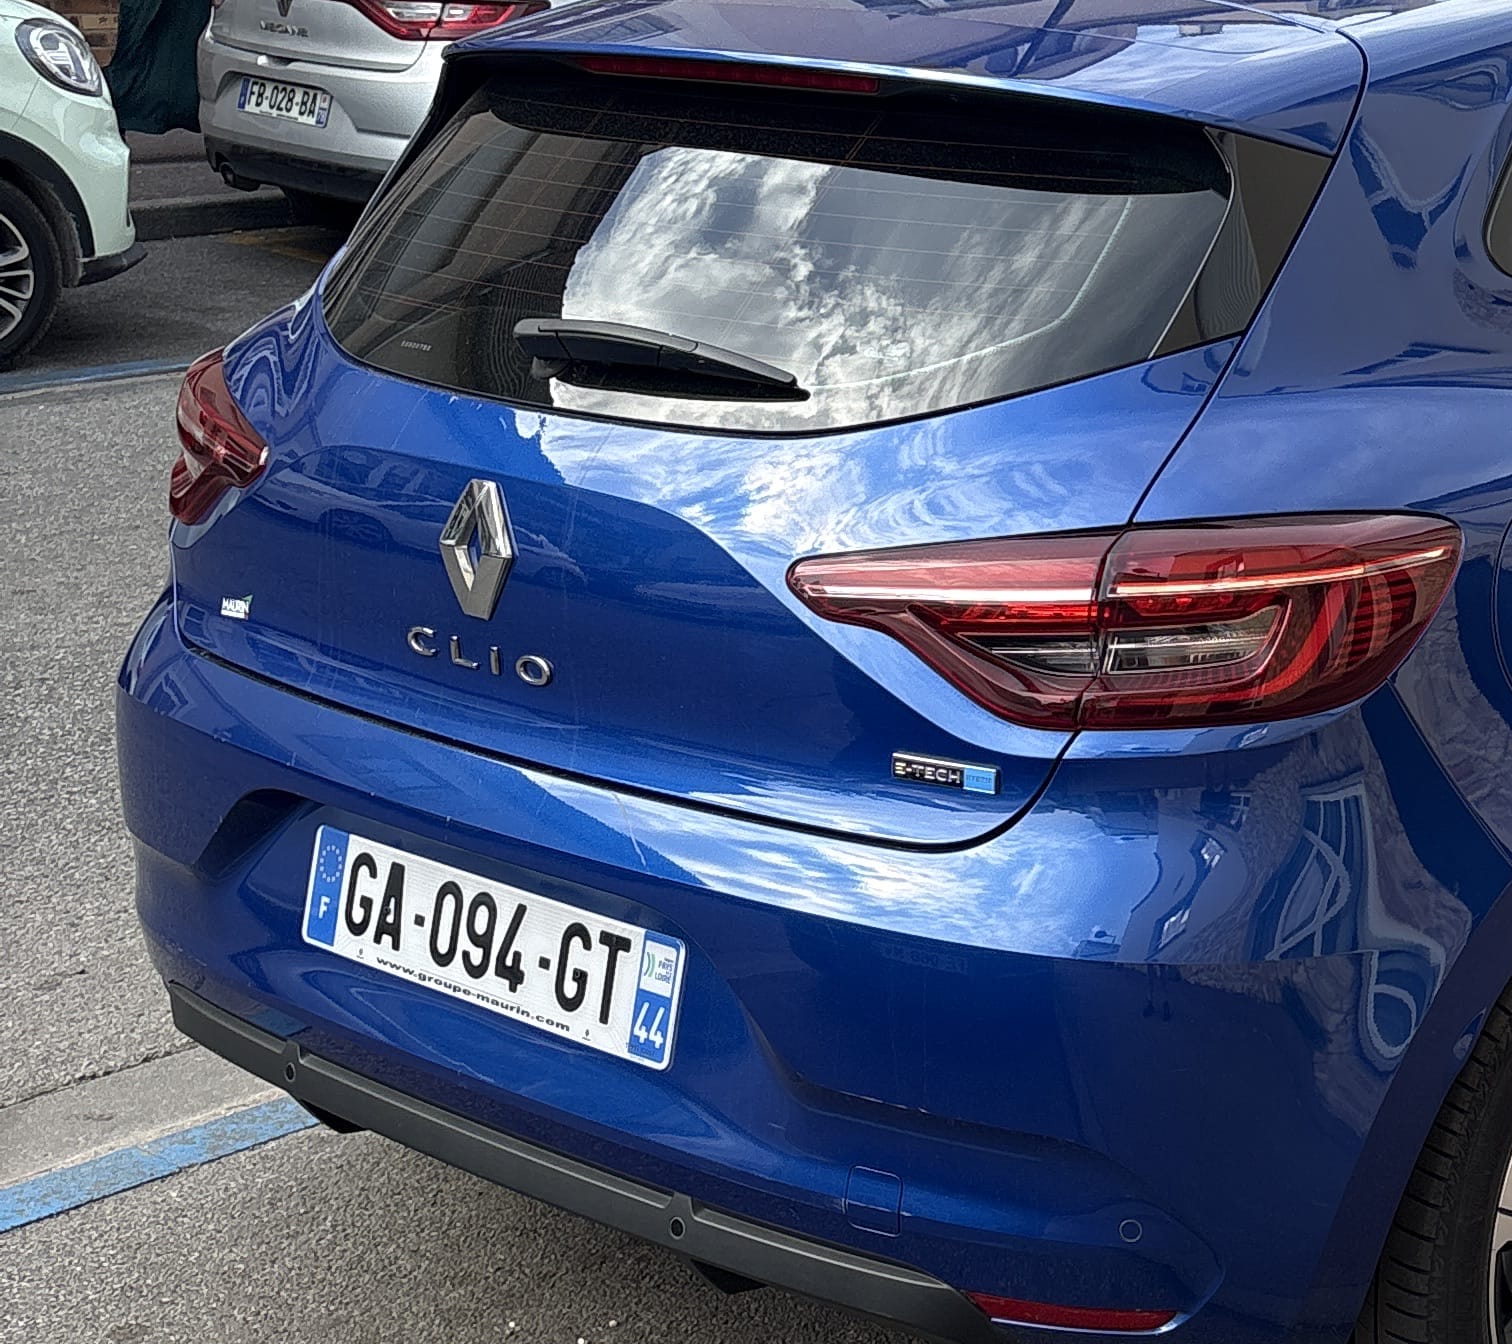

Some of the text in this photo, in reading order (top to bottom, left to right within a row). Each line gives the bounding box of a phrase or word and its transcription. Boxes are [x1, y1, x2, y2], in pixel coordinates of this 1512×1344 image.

[247, 79, 318, 119] FB-028-BA
[407, 625, 554, 687] CLIO
[894, 761, 961, 784] E-TECH
[317, 851, 633, 1026] F GA-094-GT
[376, 955, 571, 1033] www.groupe-maurin.com
[633, 1000, 666, 1050] 44
